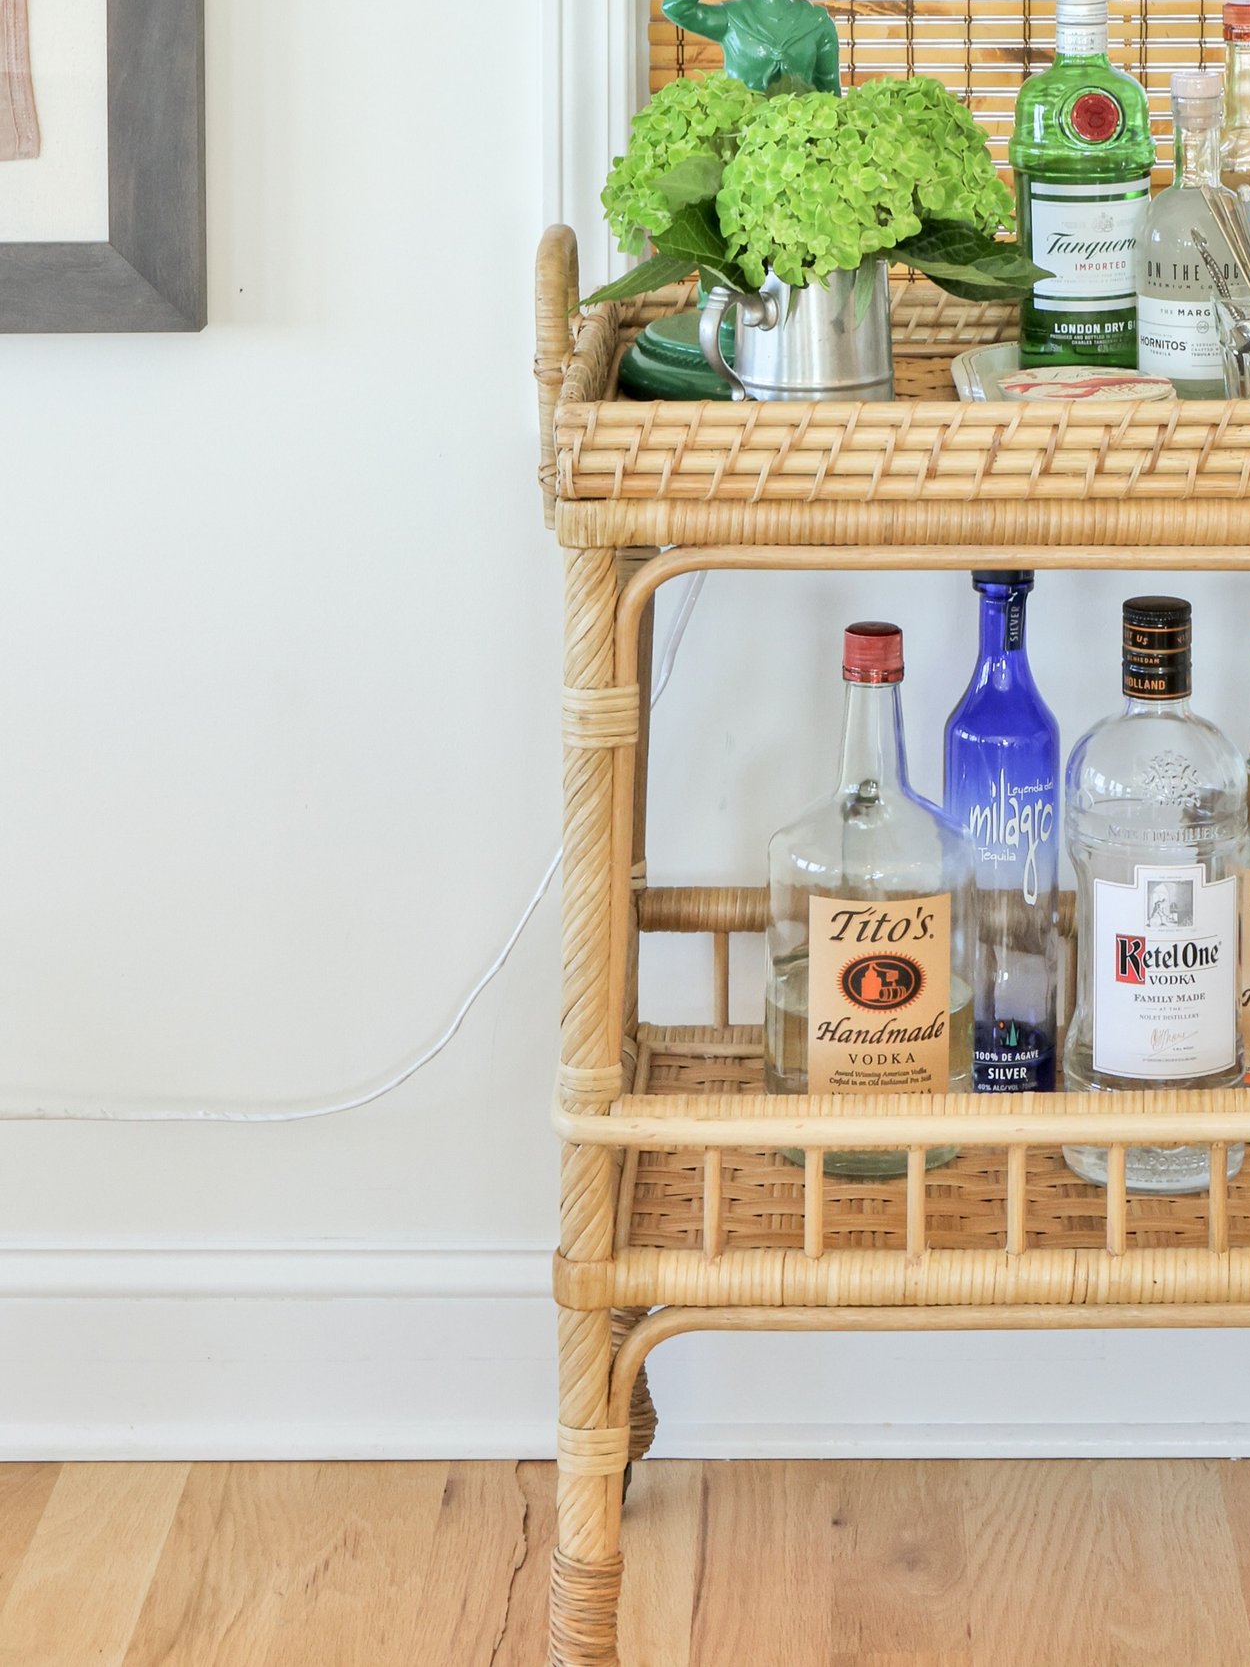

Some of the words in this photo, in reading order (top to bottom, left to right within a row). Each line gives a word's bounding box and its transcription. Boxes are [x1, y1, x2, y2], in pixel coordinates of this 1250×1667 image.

[1046, 232, 1137, 260] Tanquera
[1075, 261, 1126, 271] IMPORTED
[1147, 260, 1161, 279] ON
[1172, 264, 1199, 281] THE
[1054, 322, 1101, 334] LONDON
[1104, 321, 1125, 333] DRY
[1127, 320, 1136, 330] GI
[1140, 335, 1187, 351] HORNITOS
[1009, 606, 1020, 642] SILVER
[1136, 635, 1149, 645] US
[1007, 778, 1043, 801] Leyenda
[969, 768, 1054, 906] milagro
[978, 847, 1017, 870] Tequila
[828, 906, 934, 943] Tito's
[1117, 938, 1179, 982] Ketel
[1182, 942, 1219, 968] One
[1149, 974, 1197, 985] VODKA
[1134, 993, 1174, 1003] FAMILY
[1176, 992, 1206, 1002] MADE
[815, 1010, 945, 1045] Handmade
[848, 1052, 916, 1066] VODKA
[975, 1051, 998, 1062] 100%
[1001, 1053, 1012, 1062] DE
[1015, 1050, 1039, 1061] AGAVE
[988, 1067, 1027, 1080] SILVER
